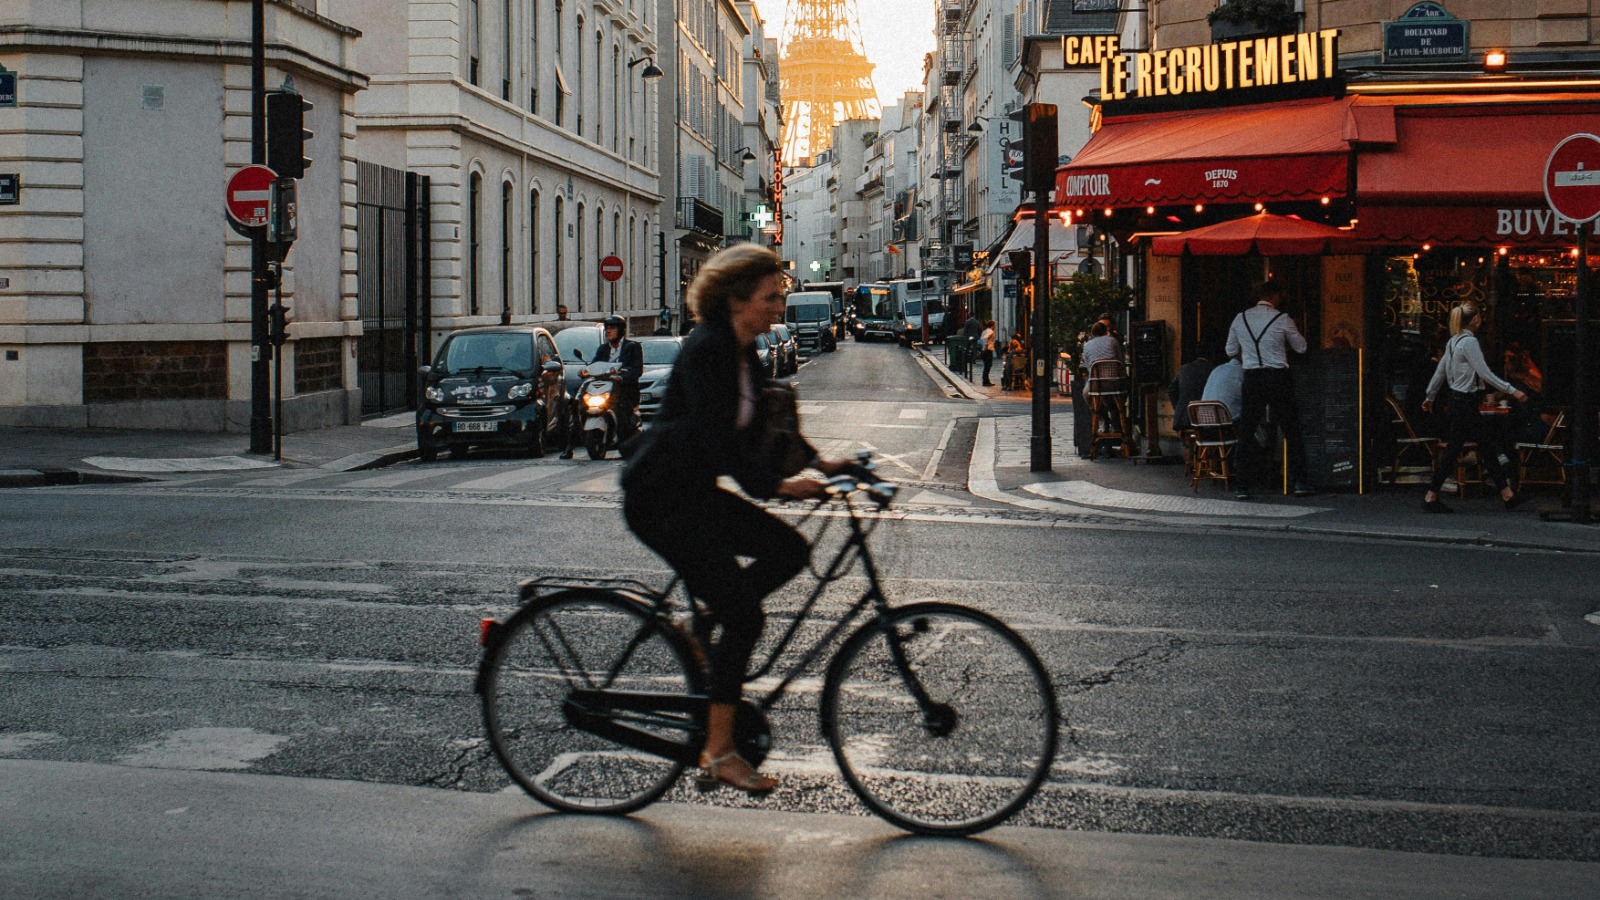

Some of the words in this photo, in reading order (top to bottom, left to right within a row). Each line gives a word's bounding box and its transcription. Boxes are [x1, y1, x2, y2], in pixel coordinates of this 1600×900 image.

[1405, 28, 1447, 36] BOULEVARD
[1401, 47, 1463, 55] TOUR-MAUBOURG
[1101, 55, 1127, 101] LE
[1138, 29, 1337, 99] RECRUTEMENT
[1205, 169, 1238, 181] DEPUIS
[1066, 173, 1111, 197] COMPTOIR
[1212, 180, 1229, 188] 1870
